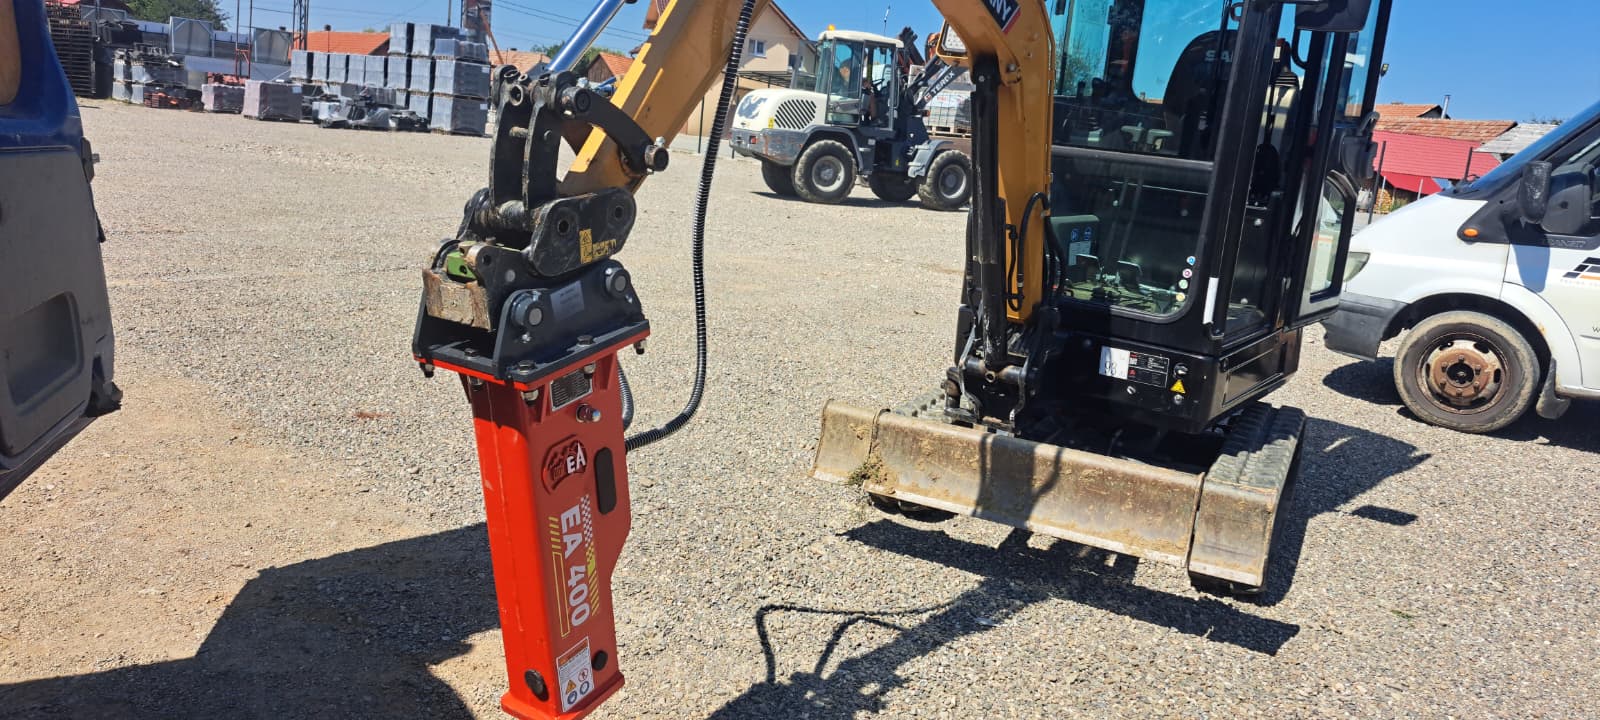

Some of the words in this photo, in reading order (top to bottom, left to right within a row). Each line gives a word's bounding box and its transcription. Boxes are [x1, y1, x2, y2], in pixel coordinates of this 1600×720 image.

[566, 442, 587, 474] EA
[560, 504, 582, 559] EA
[567, 565, 590, 626] 400
